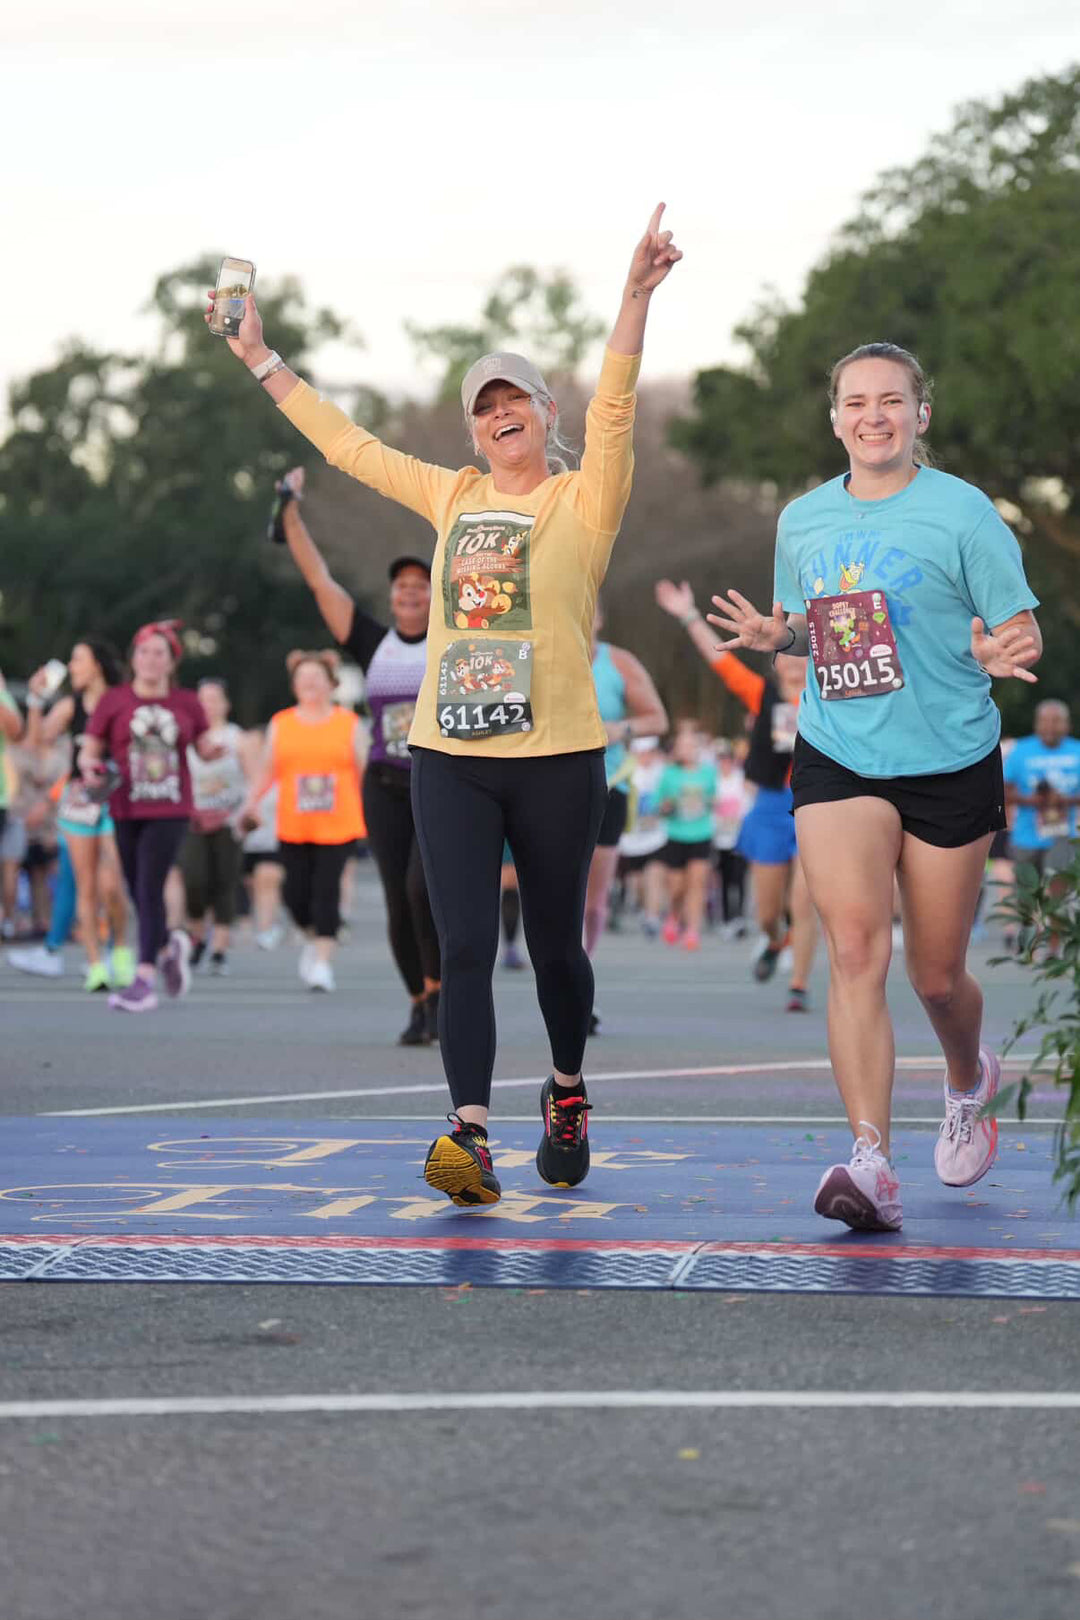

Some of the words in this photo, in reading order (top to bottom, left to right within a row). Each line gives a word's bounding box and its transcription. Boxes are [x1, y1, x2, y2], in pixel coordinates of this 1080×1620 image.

[456, 531, 501, 556] 10K
[832, 601, 849, 609] DOPEY
[469, 655, 494, 670] 10K
[518, 649, 528, 660] B
[440, 661, 448, 696] 61142
[817, 657, 896, 691] 25015
[440, 704, 527, 730] 61142
